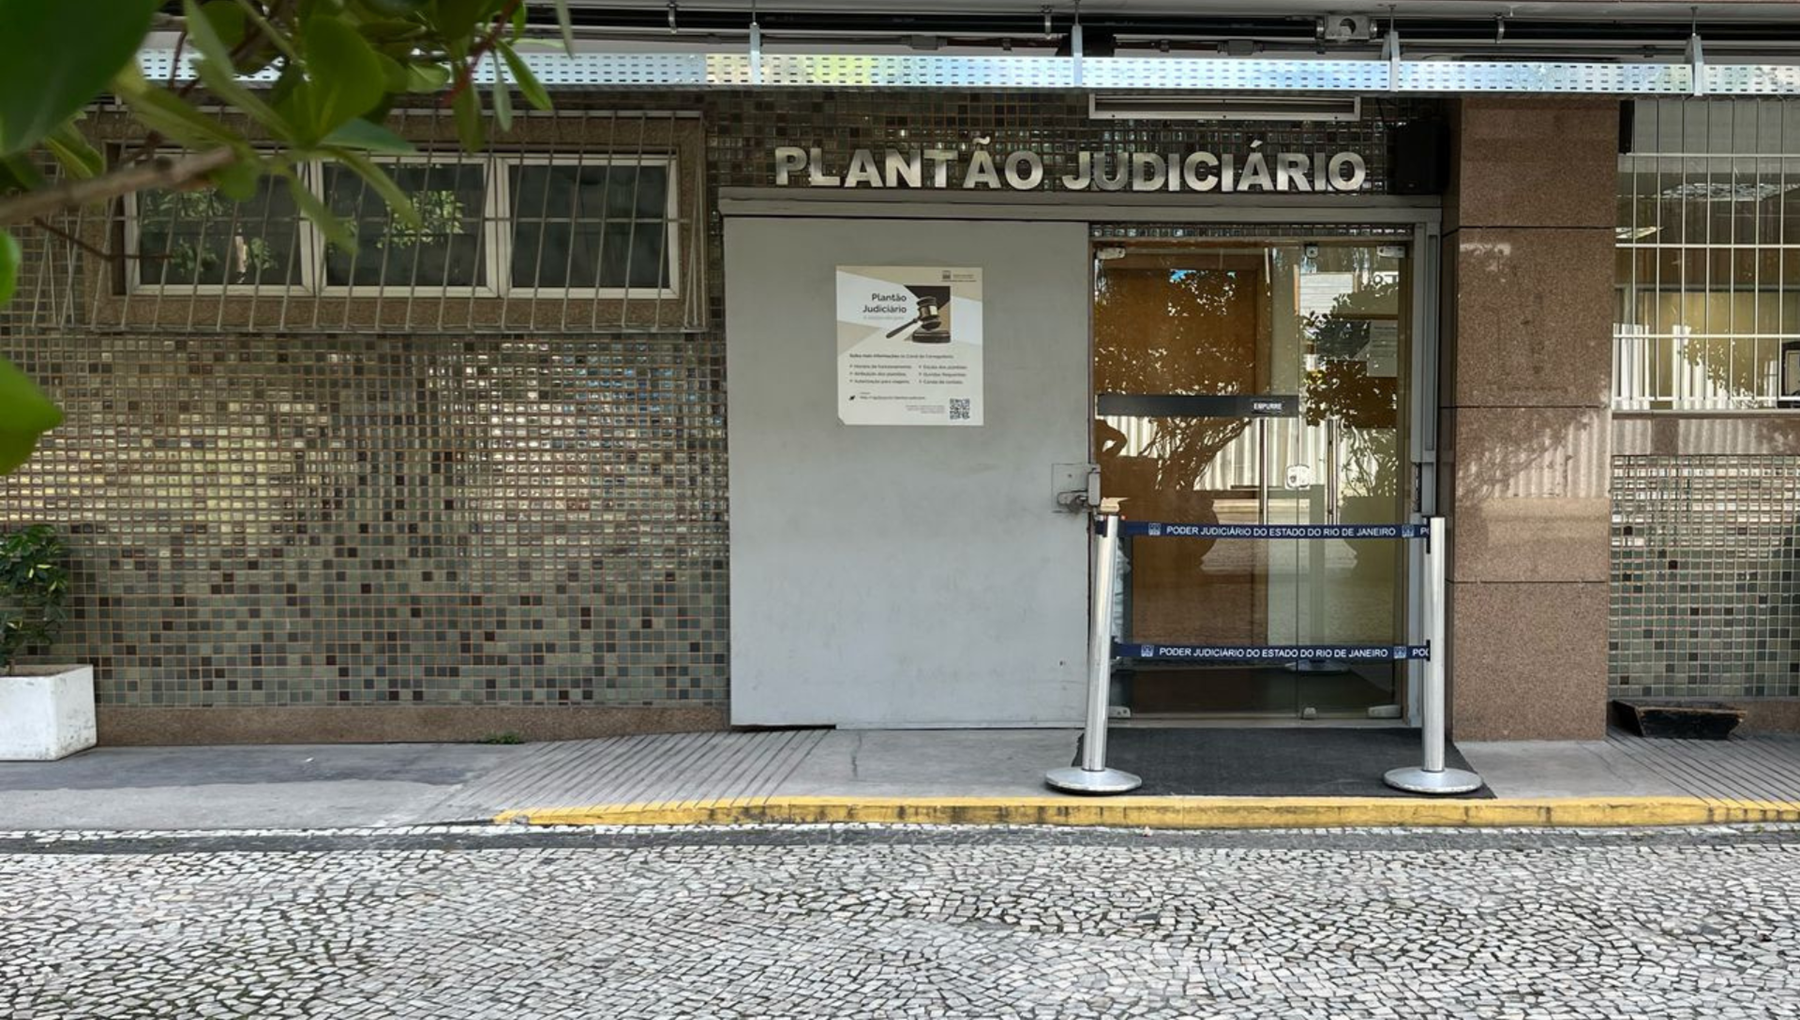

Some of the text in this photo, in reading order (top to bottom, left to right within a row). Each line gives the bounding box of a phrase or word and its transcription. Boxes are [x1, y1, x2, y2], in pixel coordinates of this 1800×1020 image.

[774, 136, 1366, 192] PLANTÃO JUDICIÁRIO
[871, 292, 907, 301] Plantão
[862, 304, 907, 313] Judiciário
[1166, 525, 1199, 535] PODER
[1200, 525, 1251, 536] JUDICIÁRIO
[1253, 527, 1267, 537] DO
[1269, 527, 1305, 536] ESTADO
[1307, 527, 1321, 536] DO
[1323, 527, 1340, 536] RIO
[1341, 527, 1354, 536] DE
[1356, 527, 1396, 536] JANEIRO
[1159, 647, 1191, 656] PODER
[1193, 647, 1244, 657] JUDICIÁRIO
[1246, 649, 1260, 657] DO
[1262, 649, 1298, 657] ESTADO
[1300, 649, 1314, 657] DO
[1316, 649, 1332, 657] RIO
[1334, 649, 1347, 657] DE
[1348, 649, 1388, 657] JANEIRO
